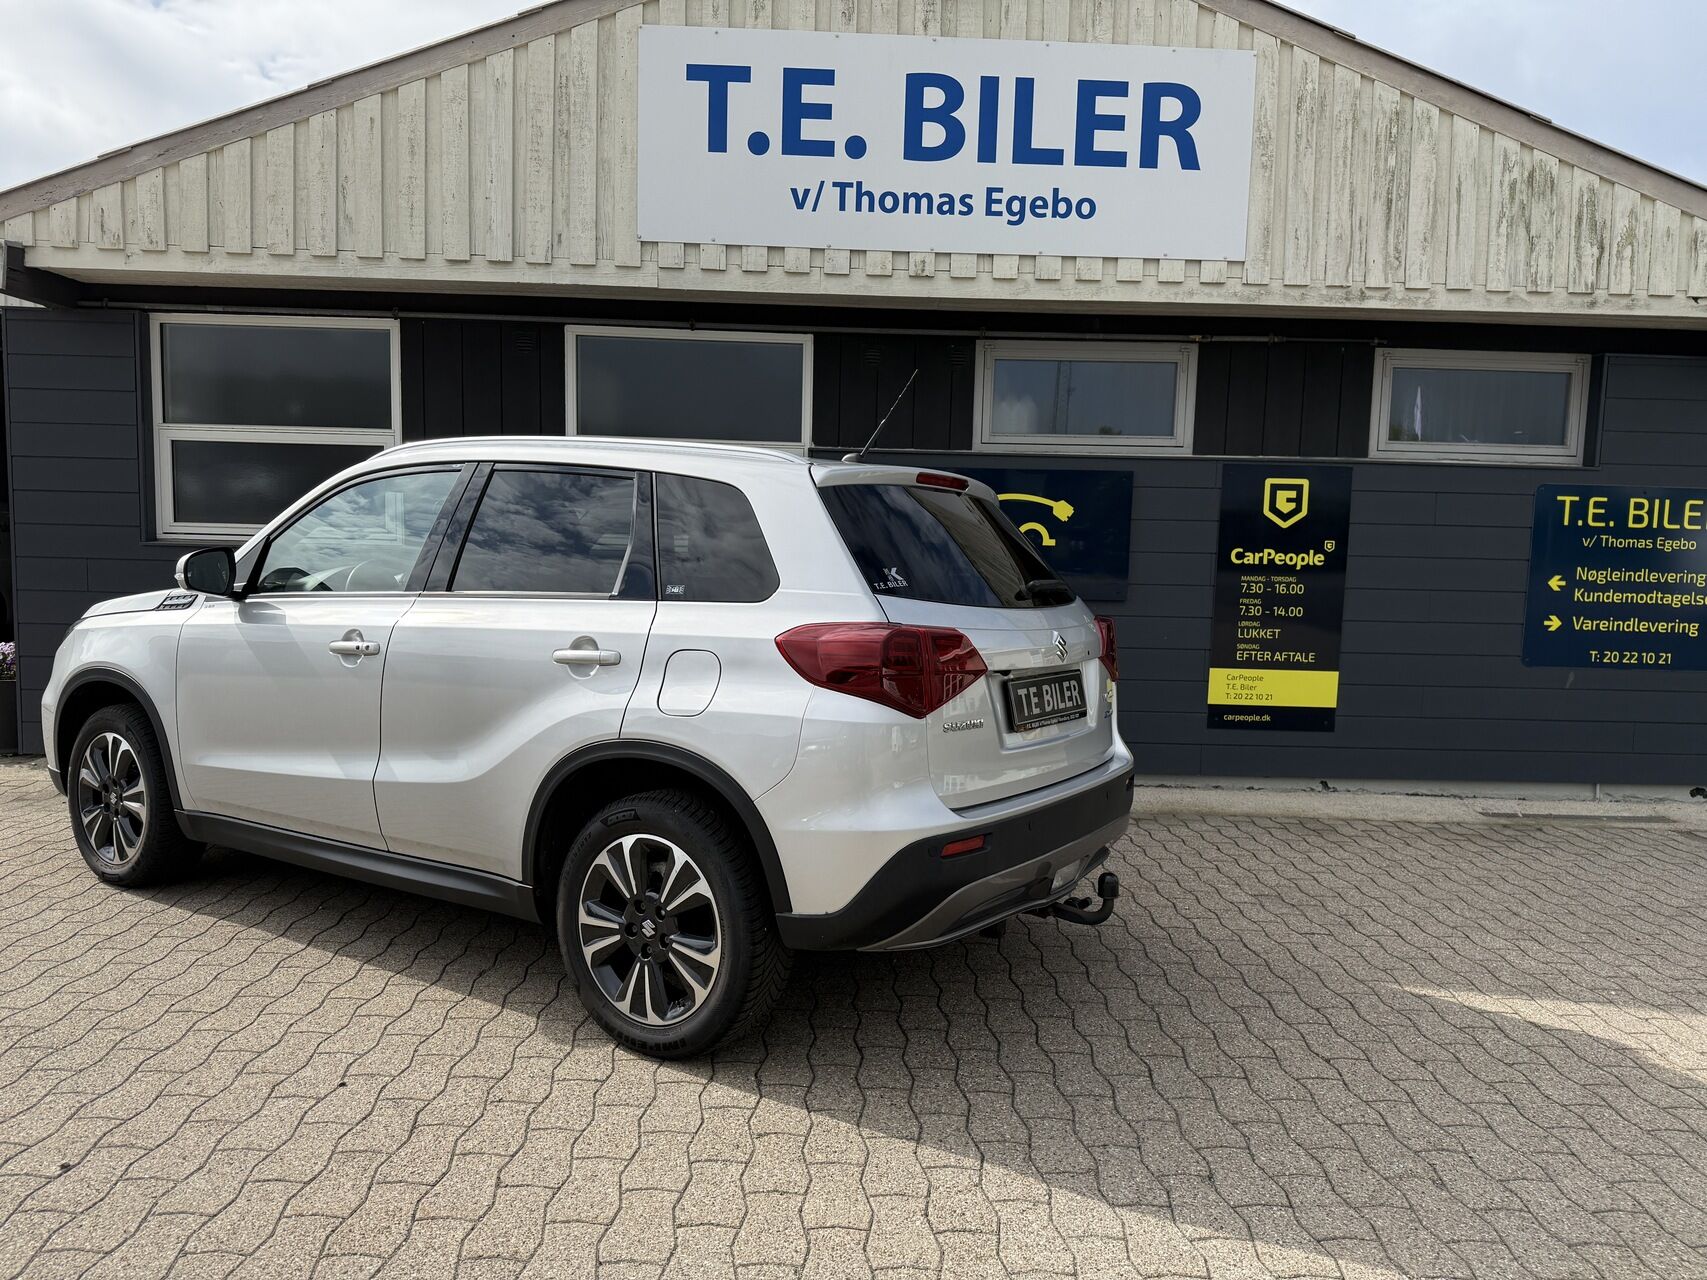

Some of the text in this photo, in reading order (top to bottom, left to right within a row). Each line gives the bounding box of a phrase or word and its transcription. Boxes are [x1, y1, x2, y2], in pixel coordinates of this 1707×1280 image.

[686, 63, 1202, 171] T.E. BILER
[790, 180, 1097, 226] v/ Thomas Egebo
[1557, 495, 1707, 530] T.E. BILE
[1582, 535, 1697, 552] v/ Thomas Egebo
[1230, 547, 1325, 570] CarPeople
[1576, 566, 1706, 587] Nøgleindlevering
[887, 580, 908, 588] BILER
[1240, 583, 1264, 593] 7.30
[1274, 583, 1304, 594] 16.00
[1240, 605, 1262, 616] 7.30
[1273, 606, 1304, 617] 14.00
[1238, 628, 1281, 639] LUKKET
[1572, 616, 1700, 637] Vareindlevering
[1236, 651, 1316, 663] EFTER AFTALE
[1589, 651, 1672, 665] T: 20 22 10 21
[1226, 673, 1264, 683] CarPeople
[1042, 680, 1081, 712] BILER
[1244, 693, 1254, 701] 22
[1255, 693, 1264, 701] 10
[1265, 693, 1273, 701] 21
[1223, 714, 1271, 722] carpeople.dk
